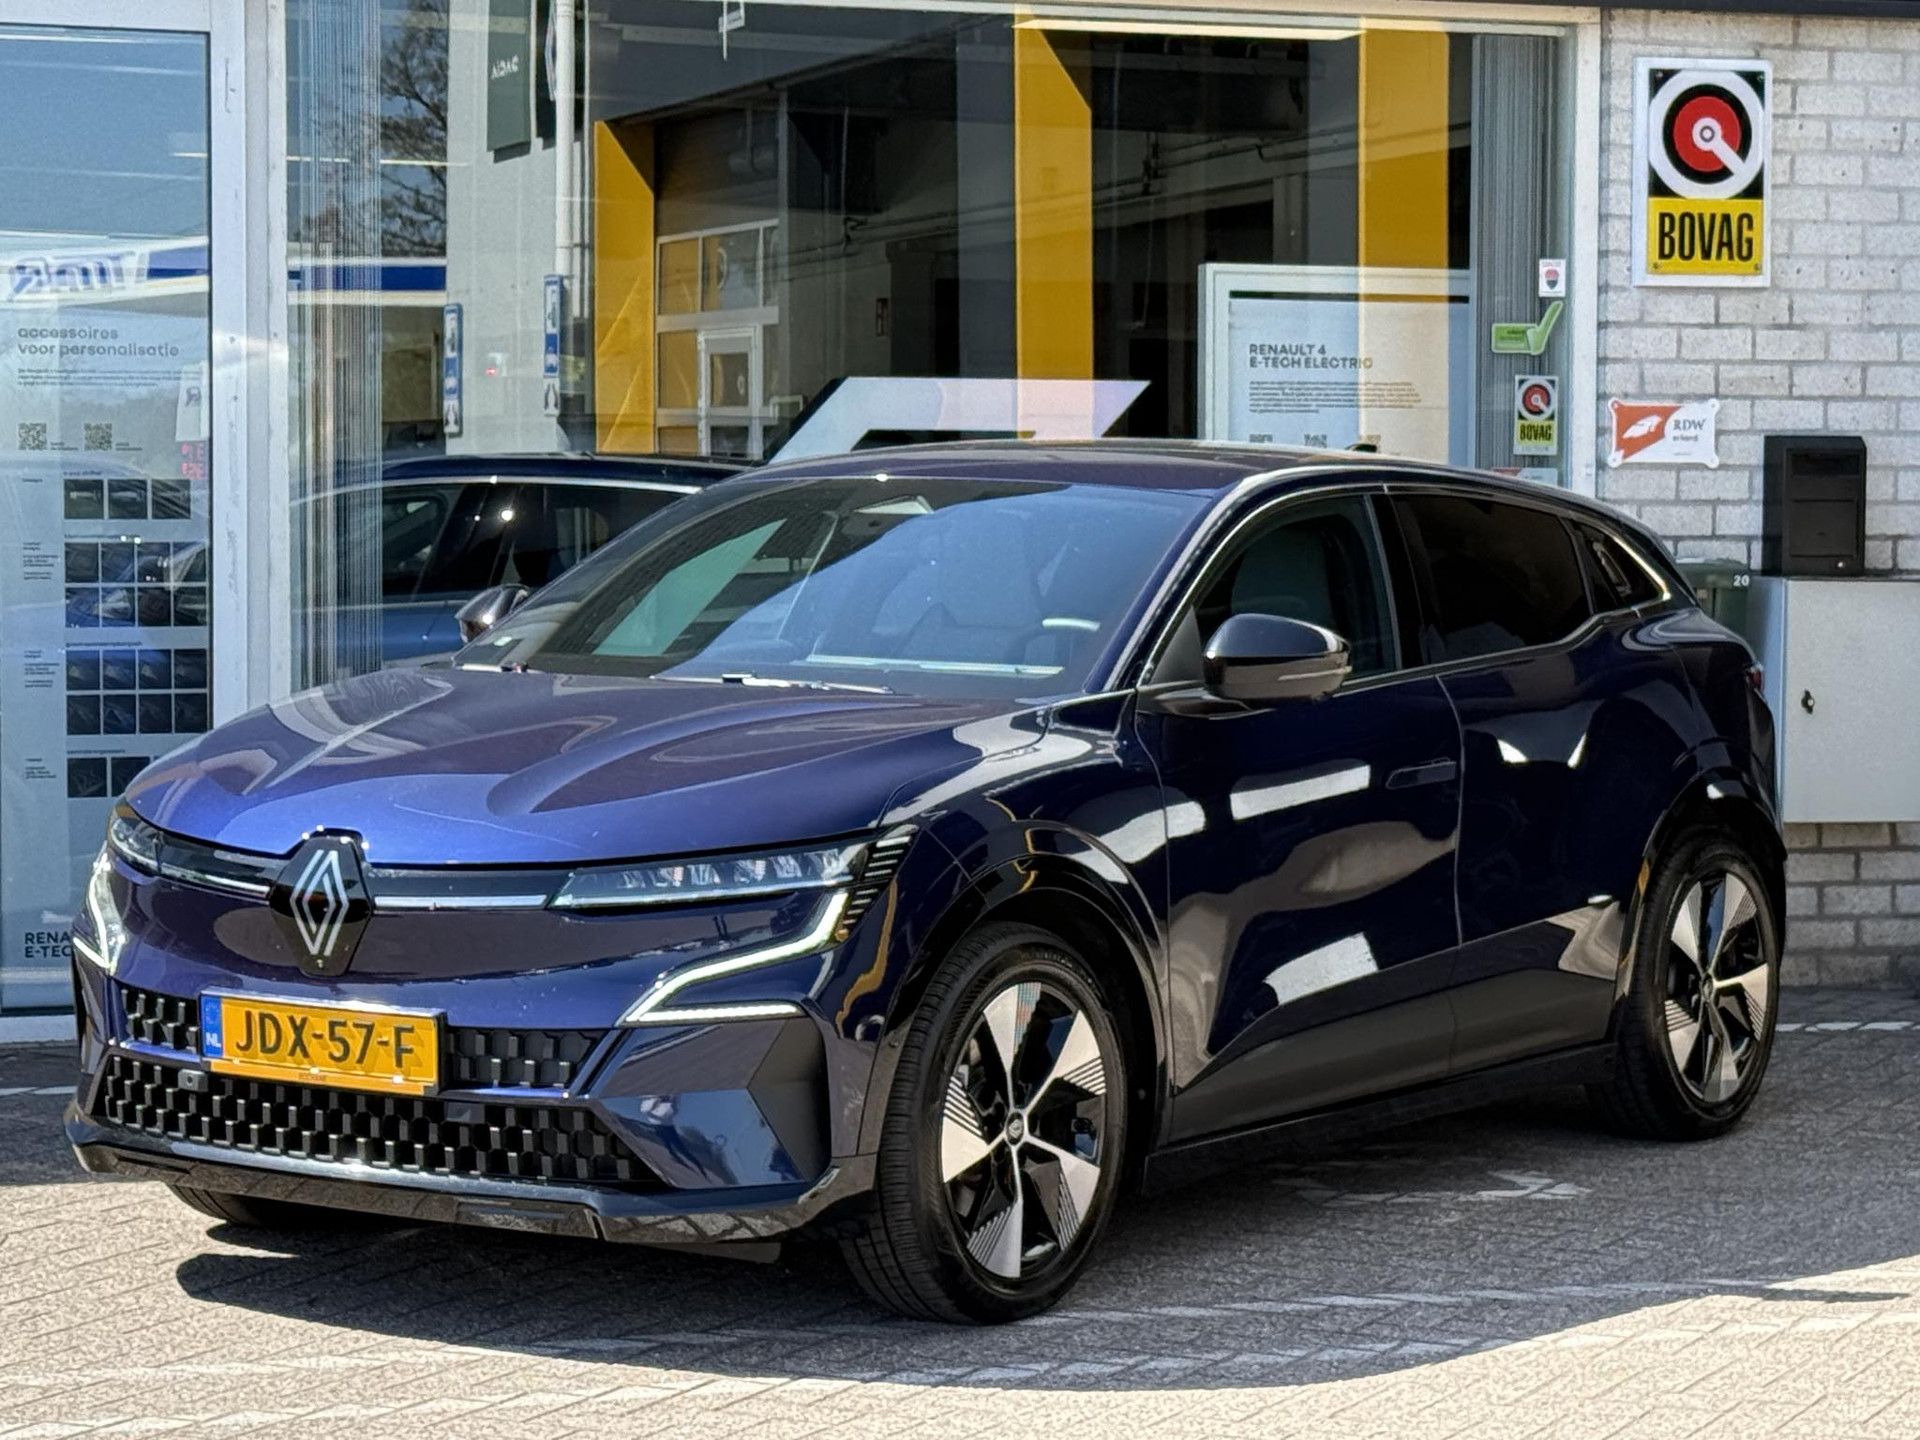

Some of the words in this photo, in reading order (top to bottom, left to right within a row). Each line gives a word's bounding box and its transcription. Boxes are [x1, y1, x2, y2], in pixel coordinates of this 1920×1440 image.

[1658, 211, 1754, 261] BOVAG
[17, 326, 119, 340] accessoires
[17, 344, 56, 355] voor
[59, 342, 180, 358] personalisatie
[1249, 343, 1316, 356] RENAULT
[1317, 344, 1327, 355] 4
[1249, 356, 1302, 369] E-TECH
[1304, 357, 1374, 369] ELECTRIC
[1519, 423, 1553, 441] BOVAG
[1673, 418, 1707, 431] RDW
[1733, 574, 1750, 587] 20
[205, 1032, 222, 1048] NL
[235, 1009, 415, 1069] JDX-57-F
